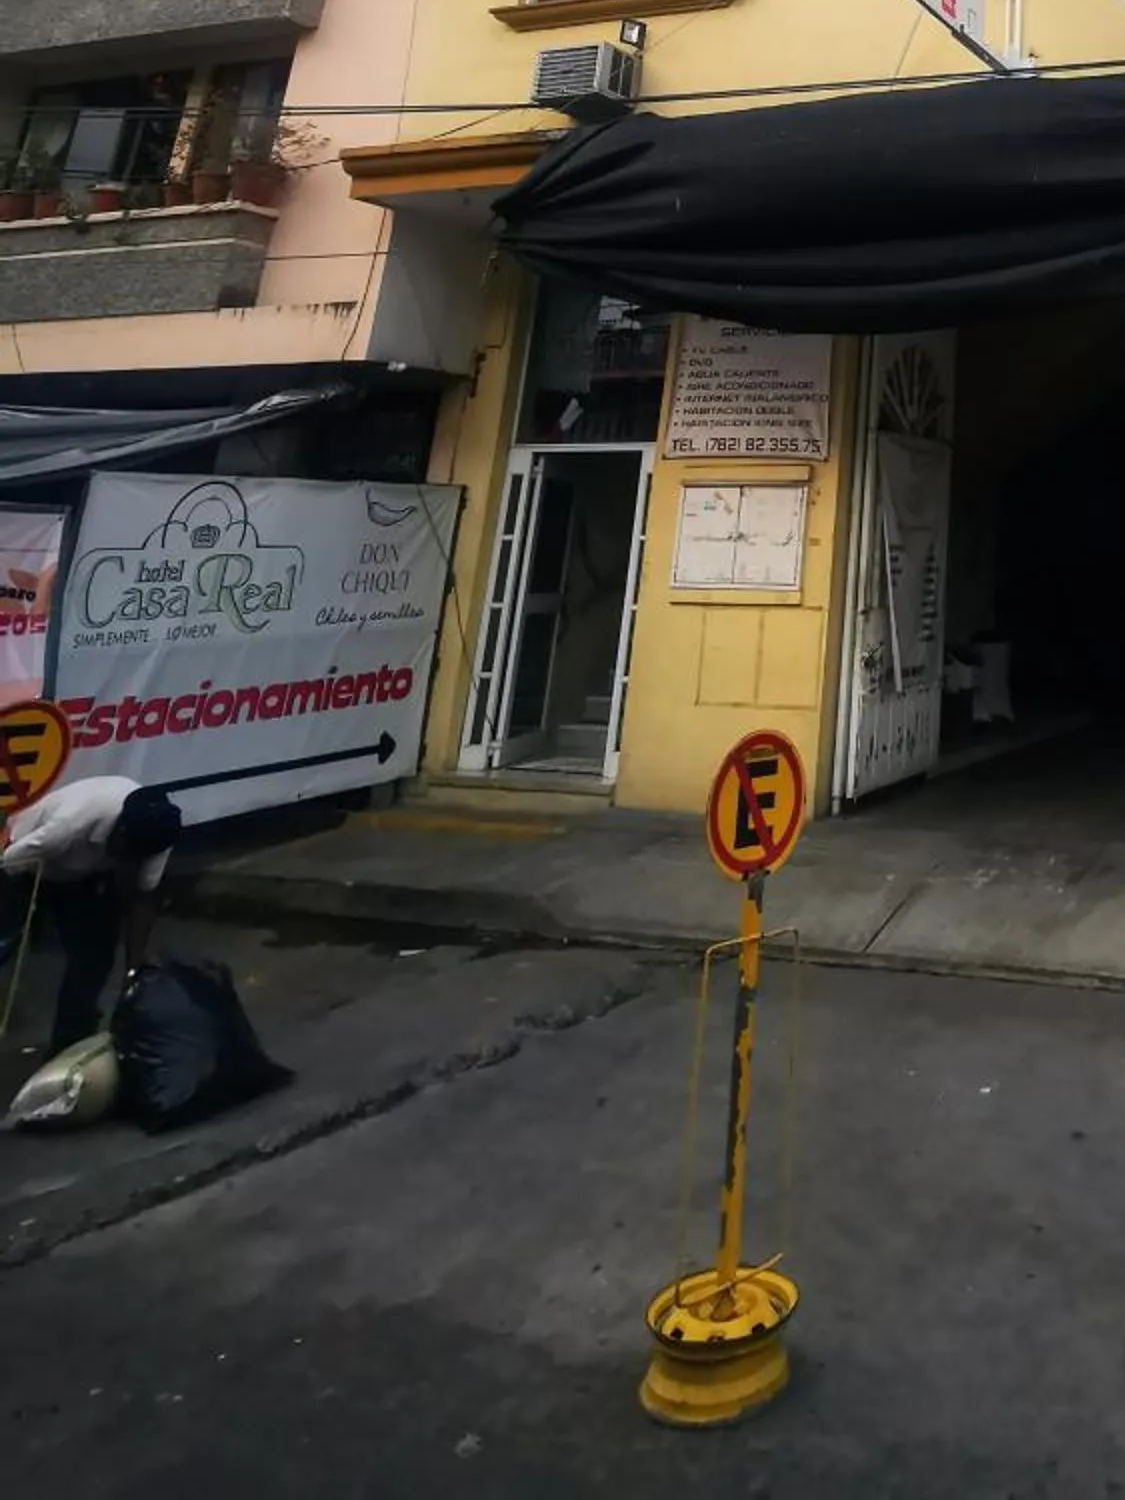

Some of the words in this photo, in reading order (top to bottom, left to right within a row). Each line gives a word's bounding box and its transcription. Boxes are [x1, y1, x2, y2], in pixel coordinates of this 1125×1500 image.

[359, 542, 400, 565] DON
[134, 559, 185, 583] hotel
[79, 554, 191, 630] Casa
[194, 552, 299, 634] Real
[72, 629, 151, 650] SIMPLEMENTE
[57, 663, 414, 749] Estacionamiento
